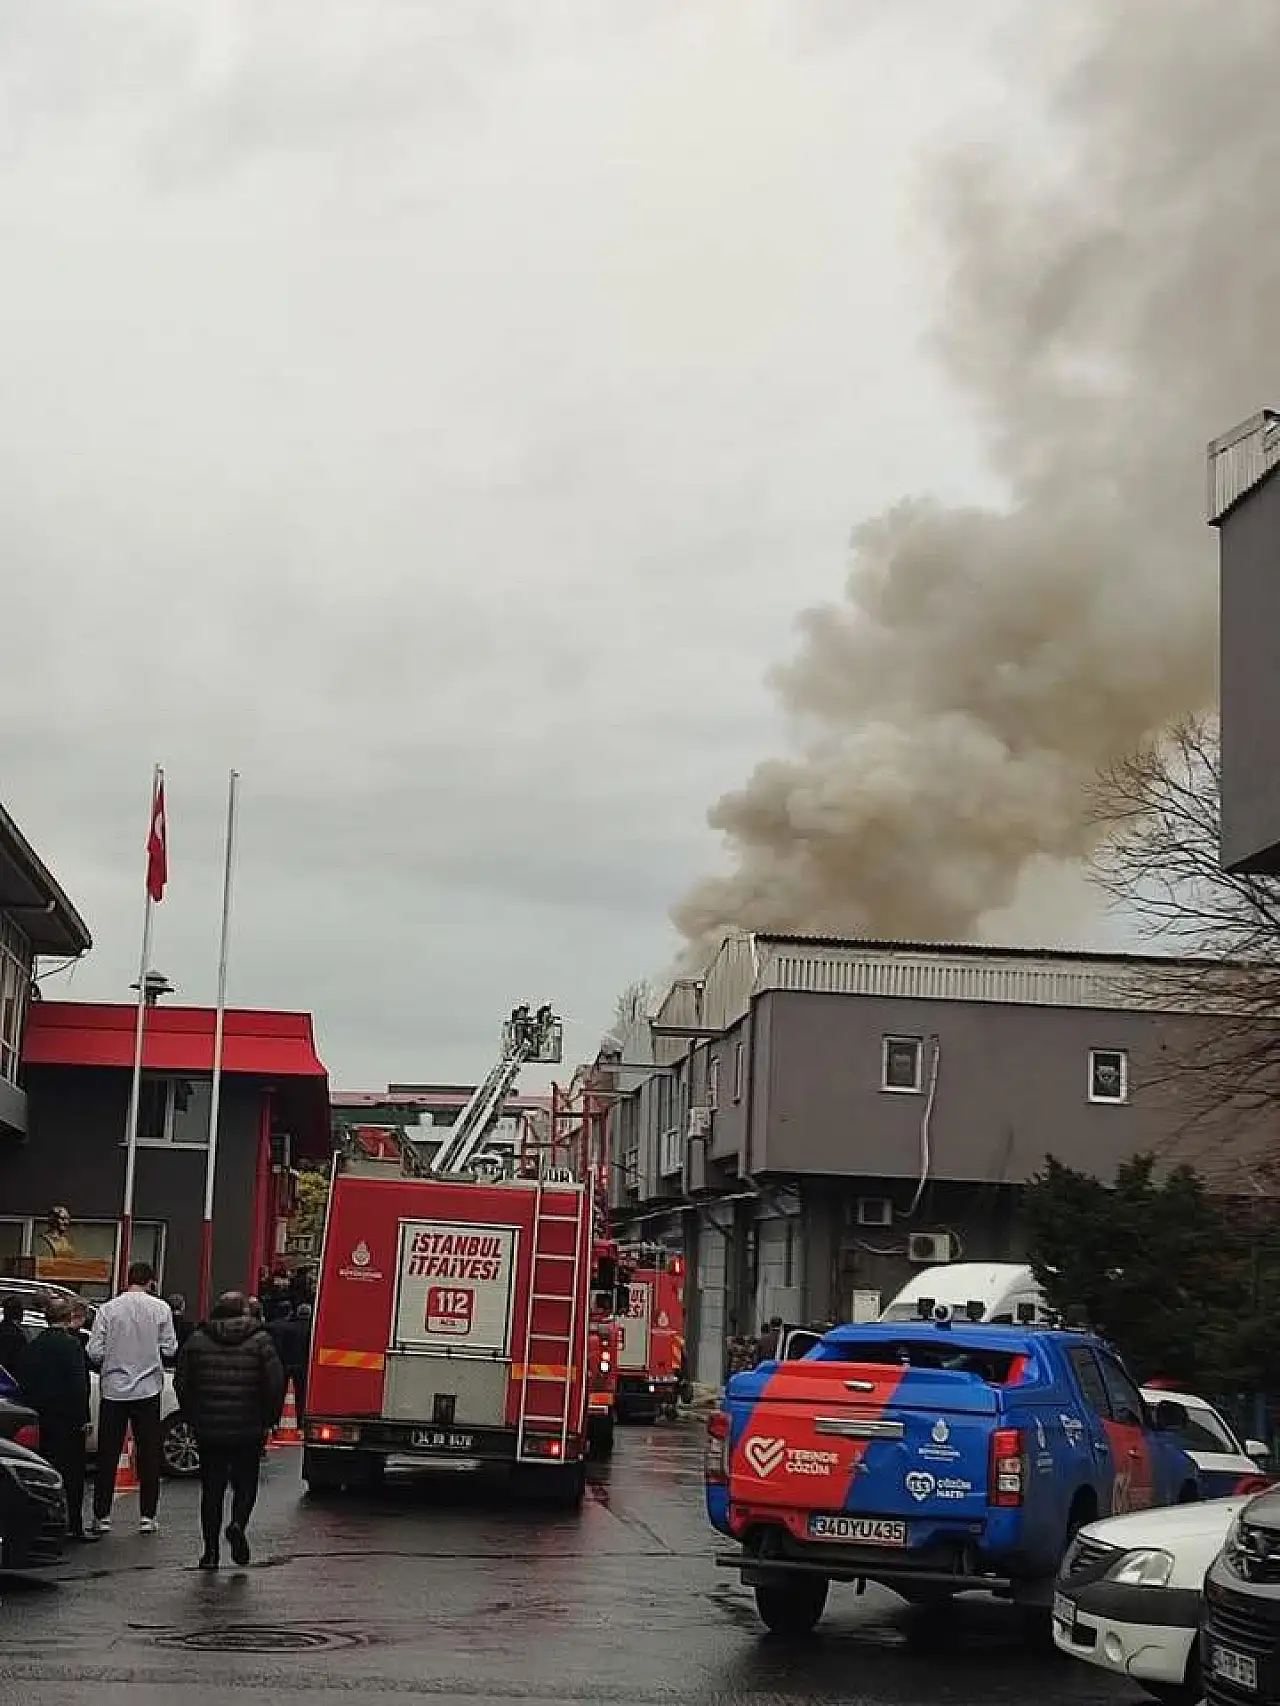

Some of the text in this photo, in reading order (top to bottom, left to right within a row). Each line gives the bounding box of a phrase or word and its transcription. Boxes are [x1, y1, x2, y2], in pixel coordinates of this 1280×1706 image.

[411, 1232, 502, 1258] İSTANBUL
[408, 1255, 502, 1280] İTFAİYESİ
[436, 1291, 469, 1314] 112
[816, 1518, 903, 1540] 34DYU435
